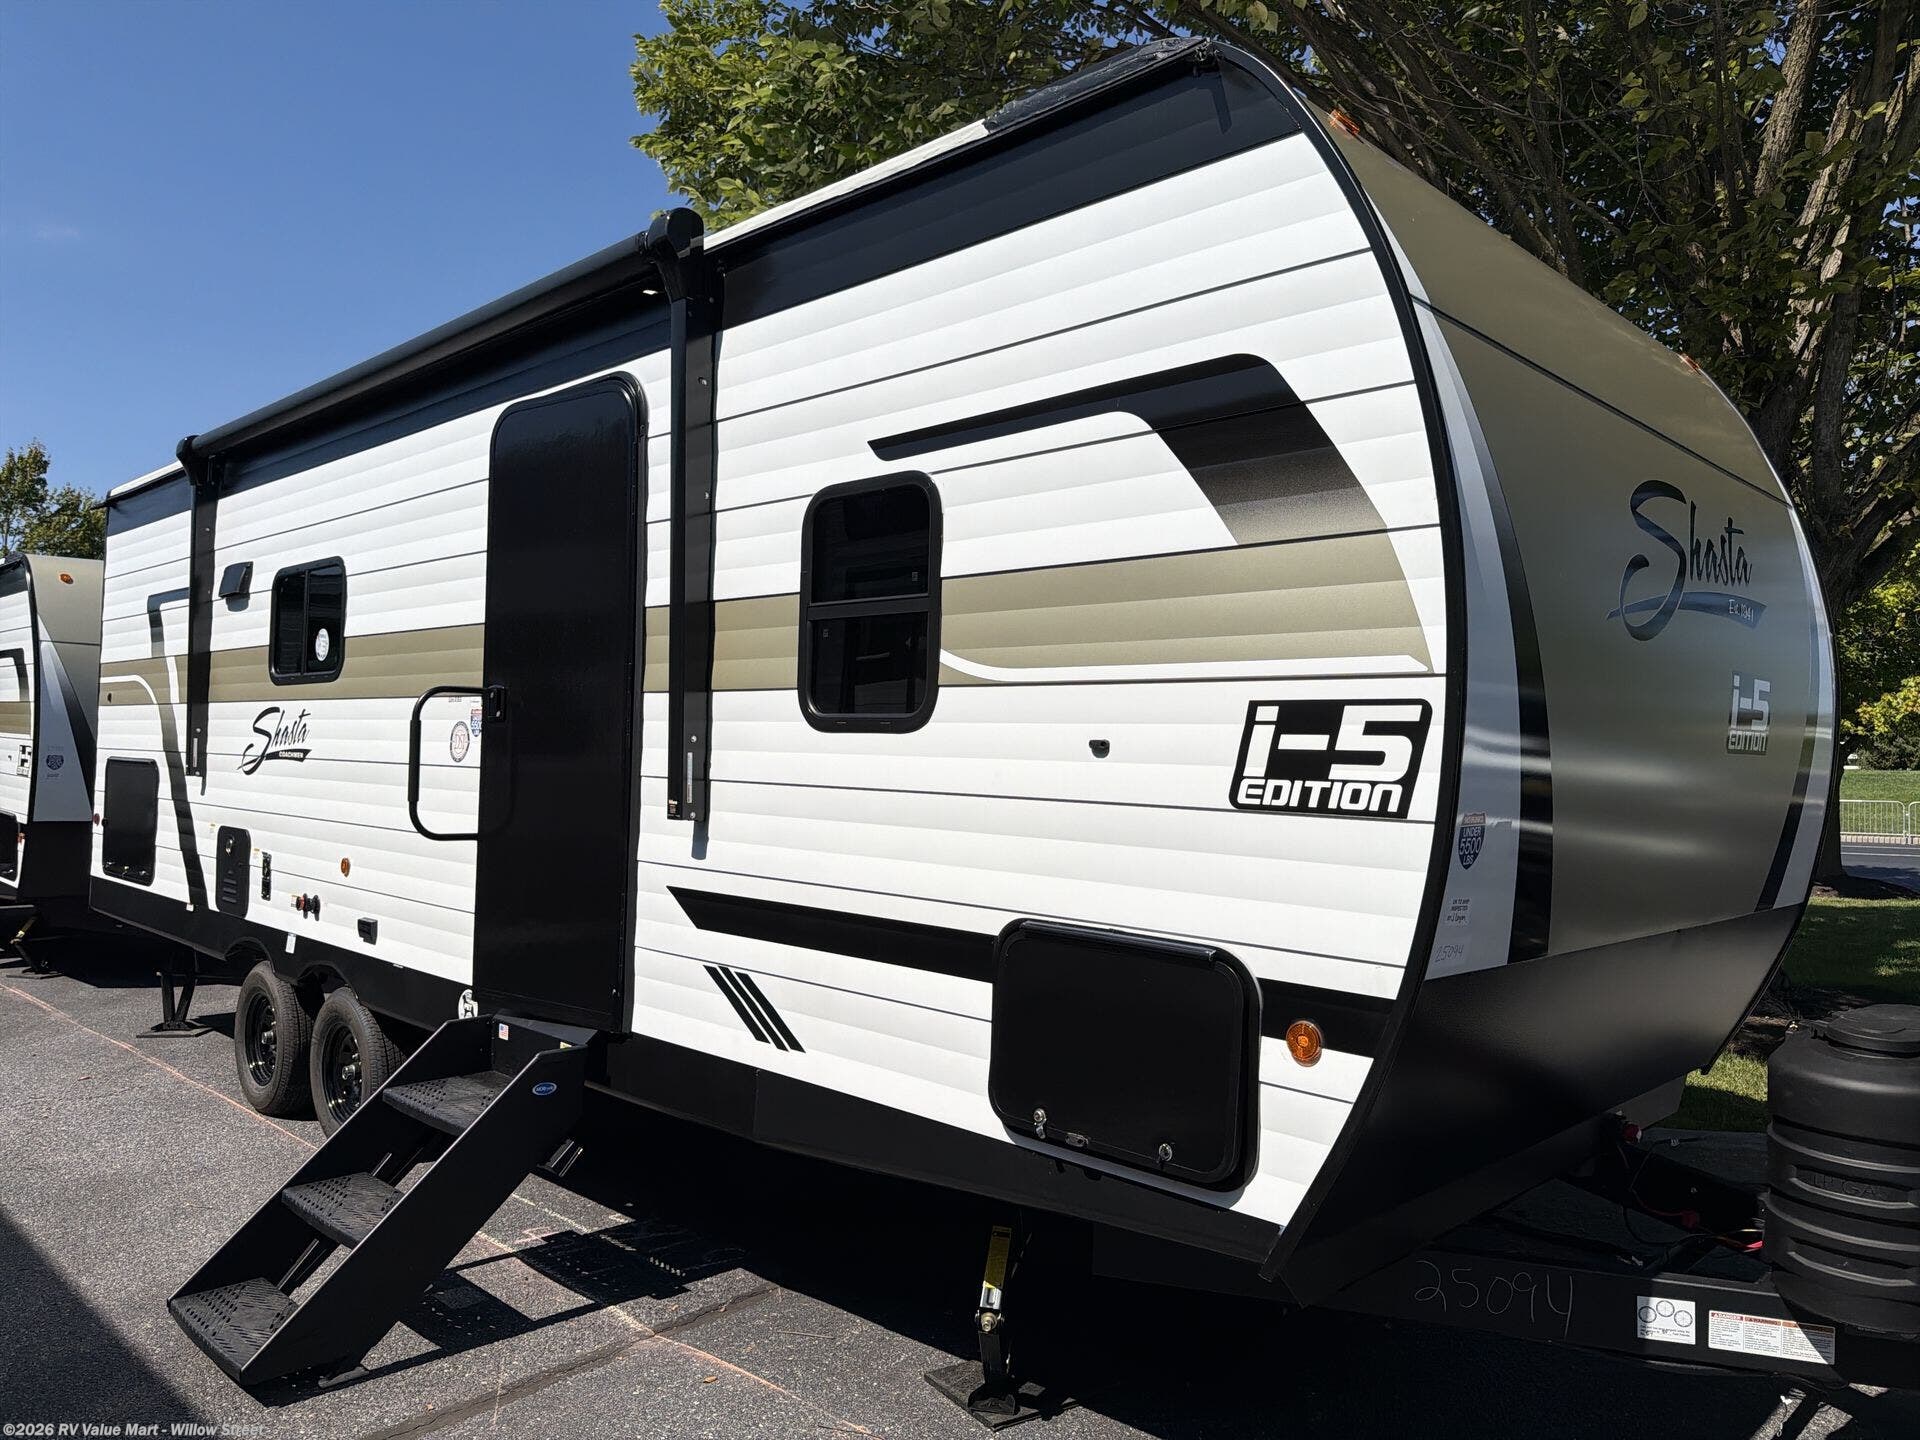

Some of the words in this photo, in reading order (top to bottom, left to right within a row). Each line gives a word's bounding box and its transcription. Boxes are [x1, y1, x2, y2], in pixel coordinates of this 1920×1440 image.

[1619, 479, 1753, 642] Shasta
[1730, 674, 1771, 731] i-5
[241, 706, 311, 776] Shasta
[1242, 704, 1423, 783] i-5
[1727, 729, 1767, 752] EDITION
[1237, 777, 1404, 814] EDITION
[1459, 837, 1482, 856] 5500
[1462, 826, 1482, 838] UNDER
[1462, 854, 1475, 866] LBS
[1414, 1260, 1573, 1338] 25094
